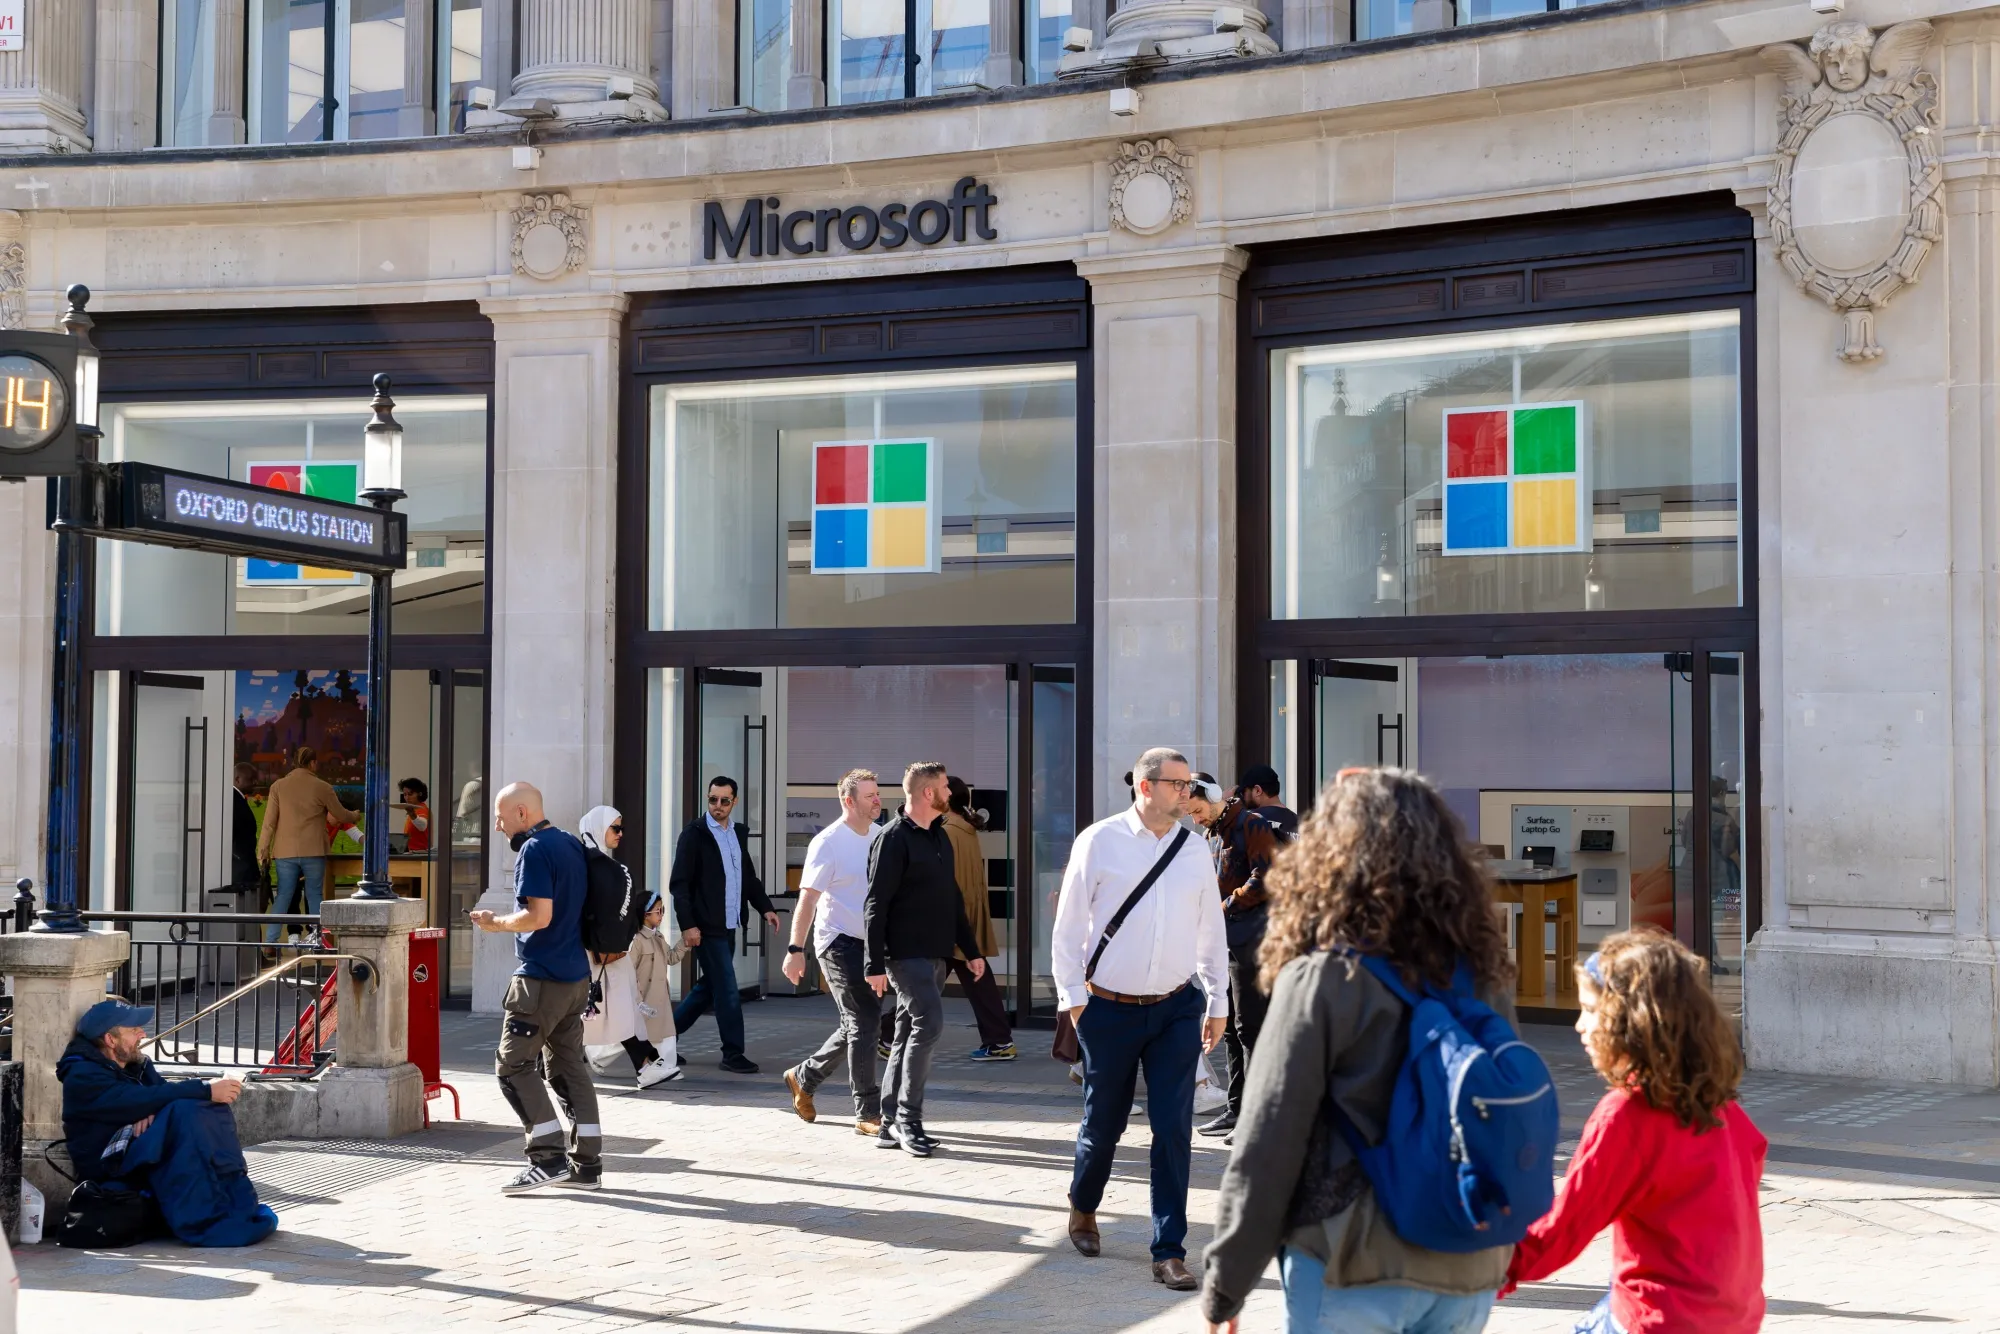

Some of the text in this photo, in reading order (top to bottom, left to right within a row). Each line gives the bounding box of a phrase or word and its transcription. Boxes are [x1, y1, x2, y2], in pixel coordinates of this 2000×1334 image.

[703, 176, 998, 259] Microsoft
[176, 488, 374, 545] OXFORD CIRCUS STATION
[1521, 825, 1561, 835] Laptop Go
[1527, 816, 1555, 824] Surface
